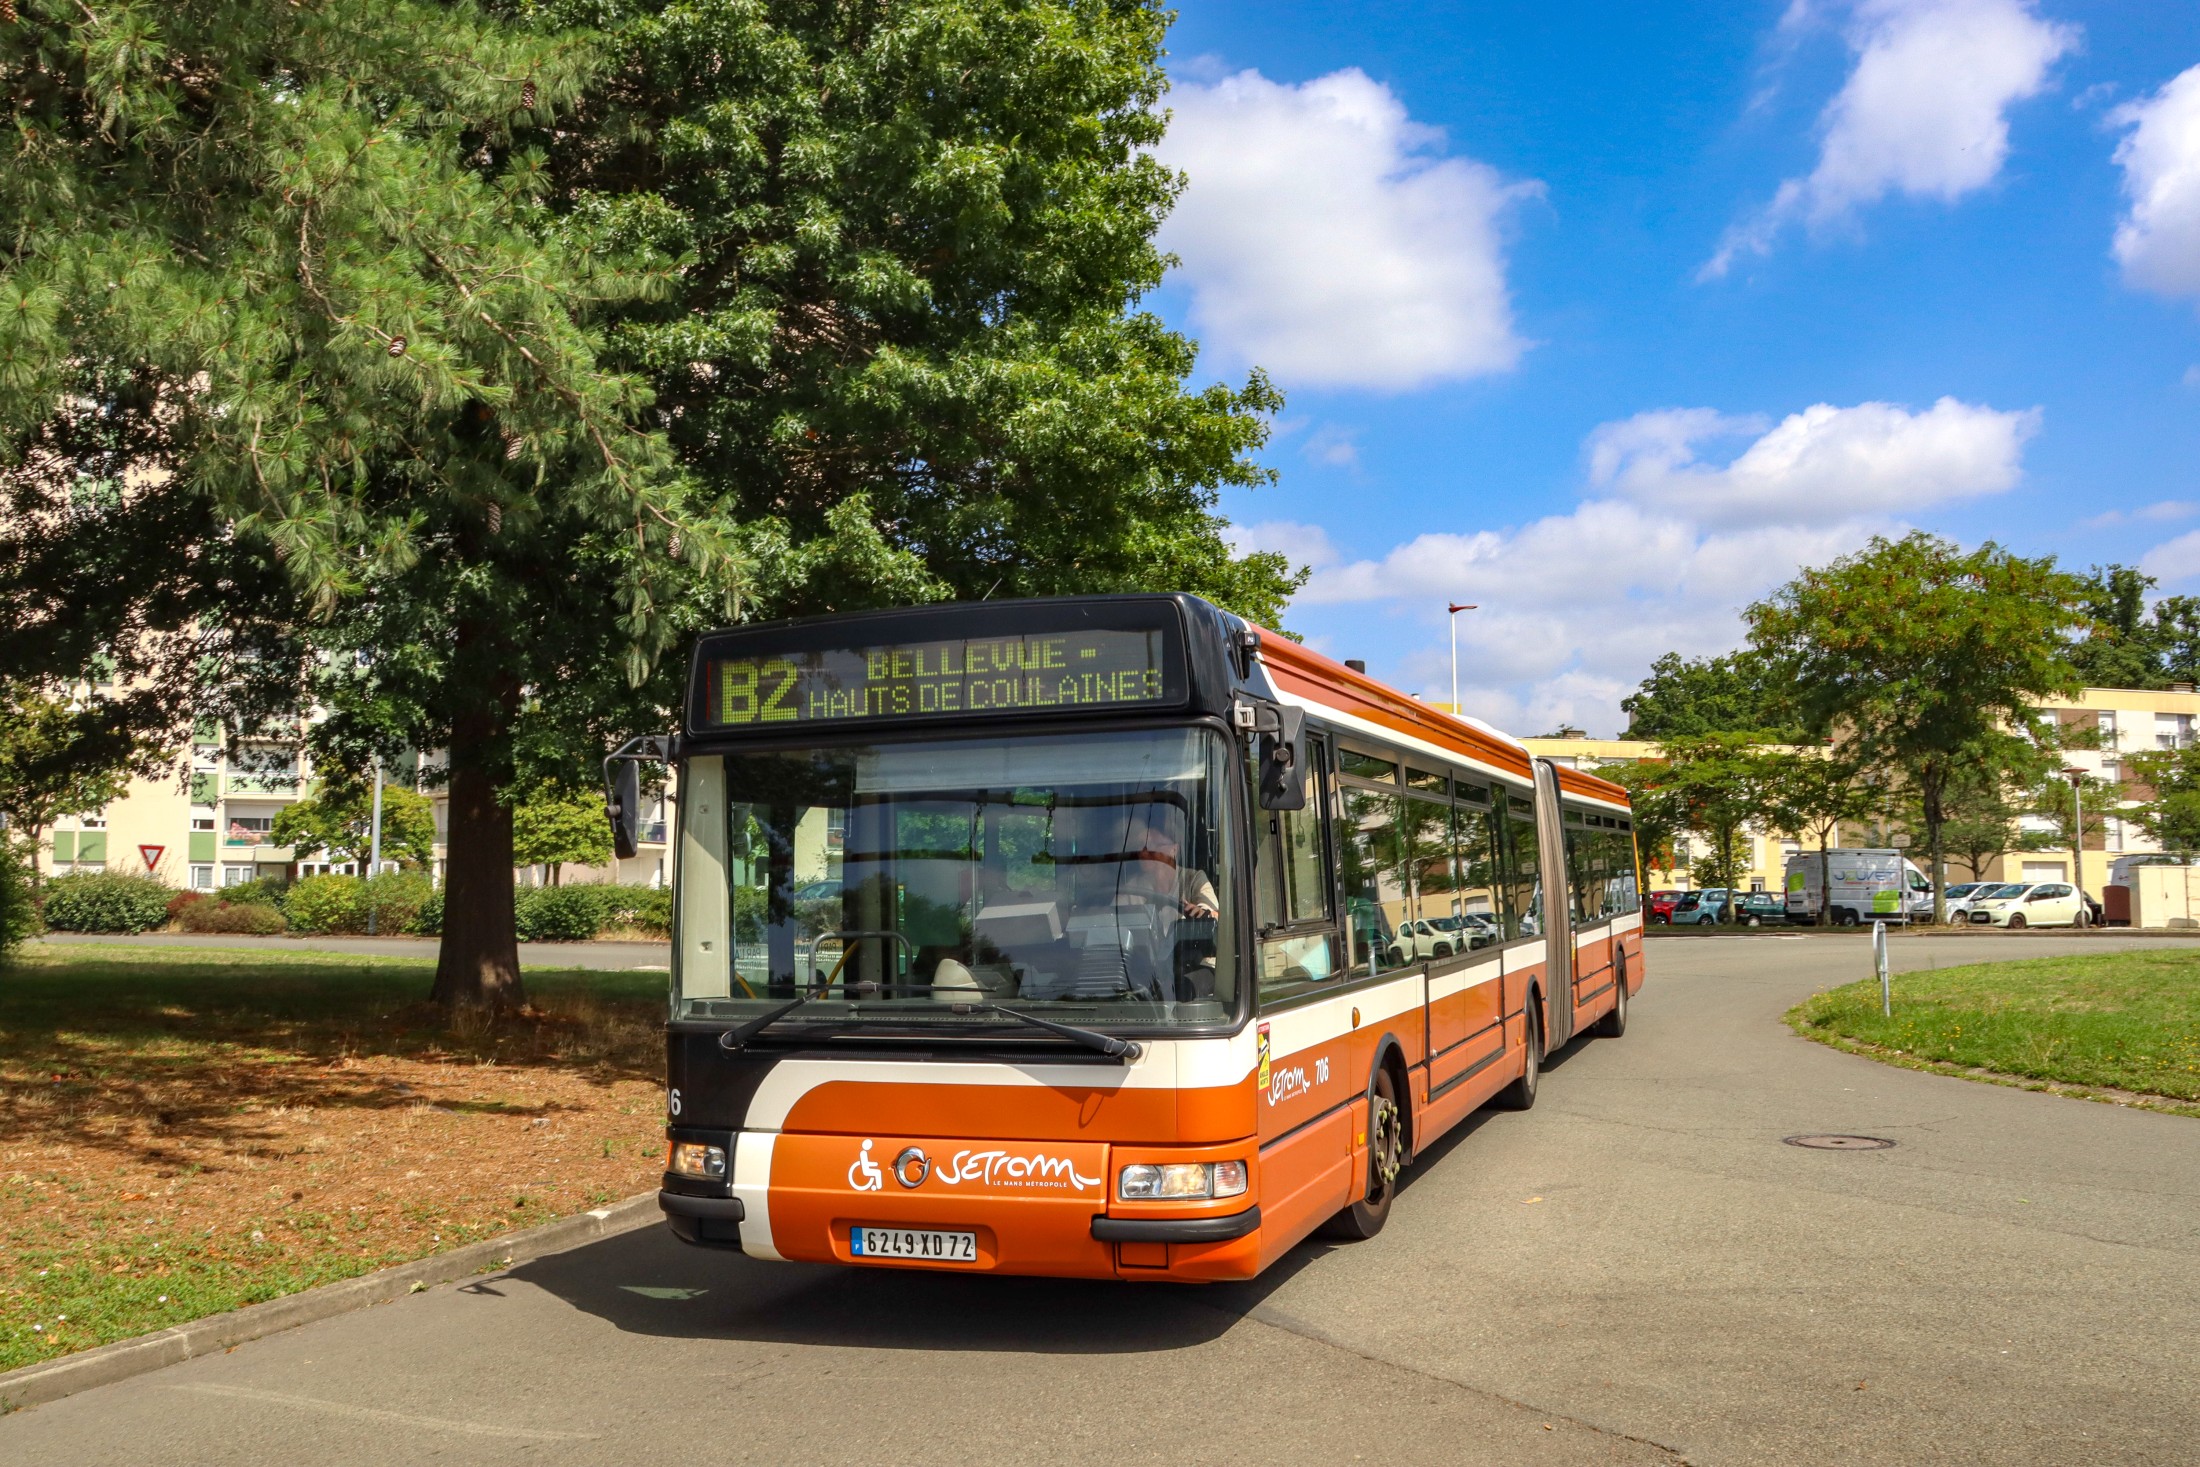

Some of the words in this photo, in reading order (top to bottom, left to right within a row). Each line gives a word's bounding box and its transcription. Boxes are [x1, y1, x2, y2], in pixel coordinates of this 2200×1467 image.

[868, 639, 1066, 680] BELLEVUE
[722, 660, 798, 723] B2
[810, 685, 910, 719] HAUTS
[920, 682, 960, 712] DE
[970, 669, 1163, 708] COULAINES
[1315, 1056, 1329, 1085] 706
[1025, 1180, 1068, 1188] MÉTROPOLE
[867, 1231, 914, 1254] 6249
[920, 1233, 942, 1256] XD
[949, 1235, 972, 1257] 72
